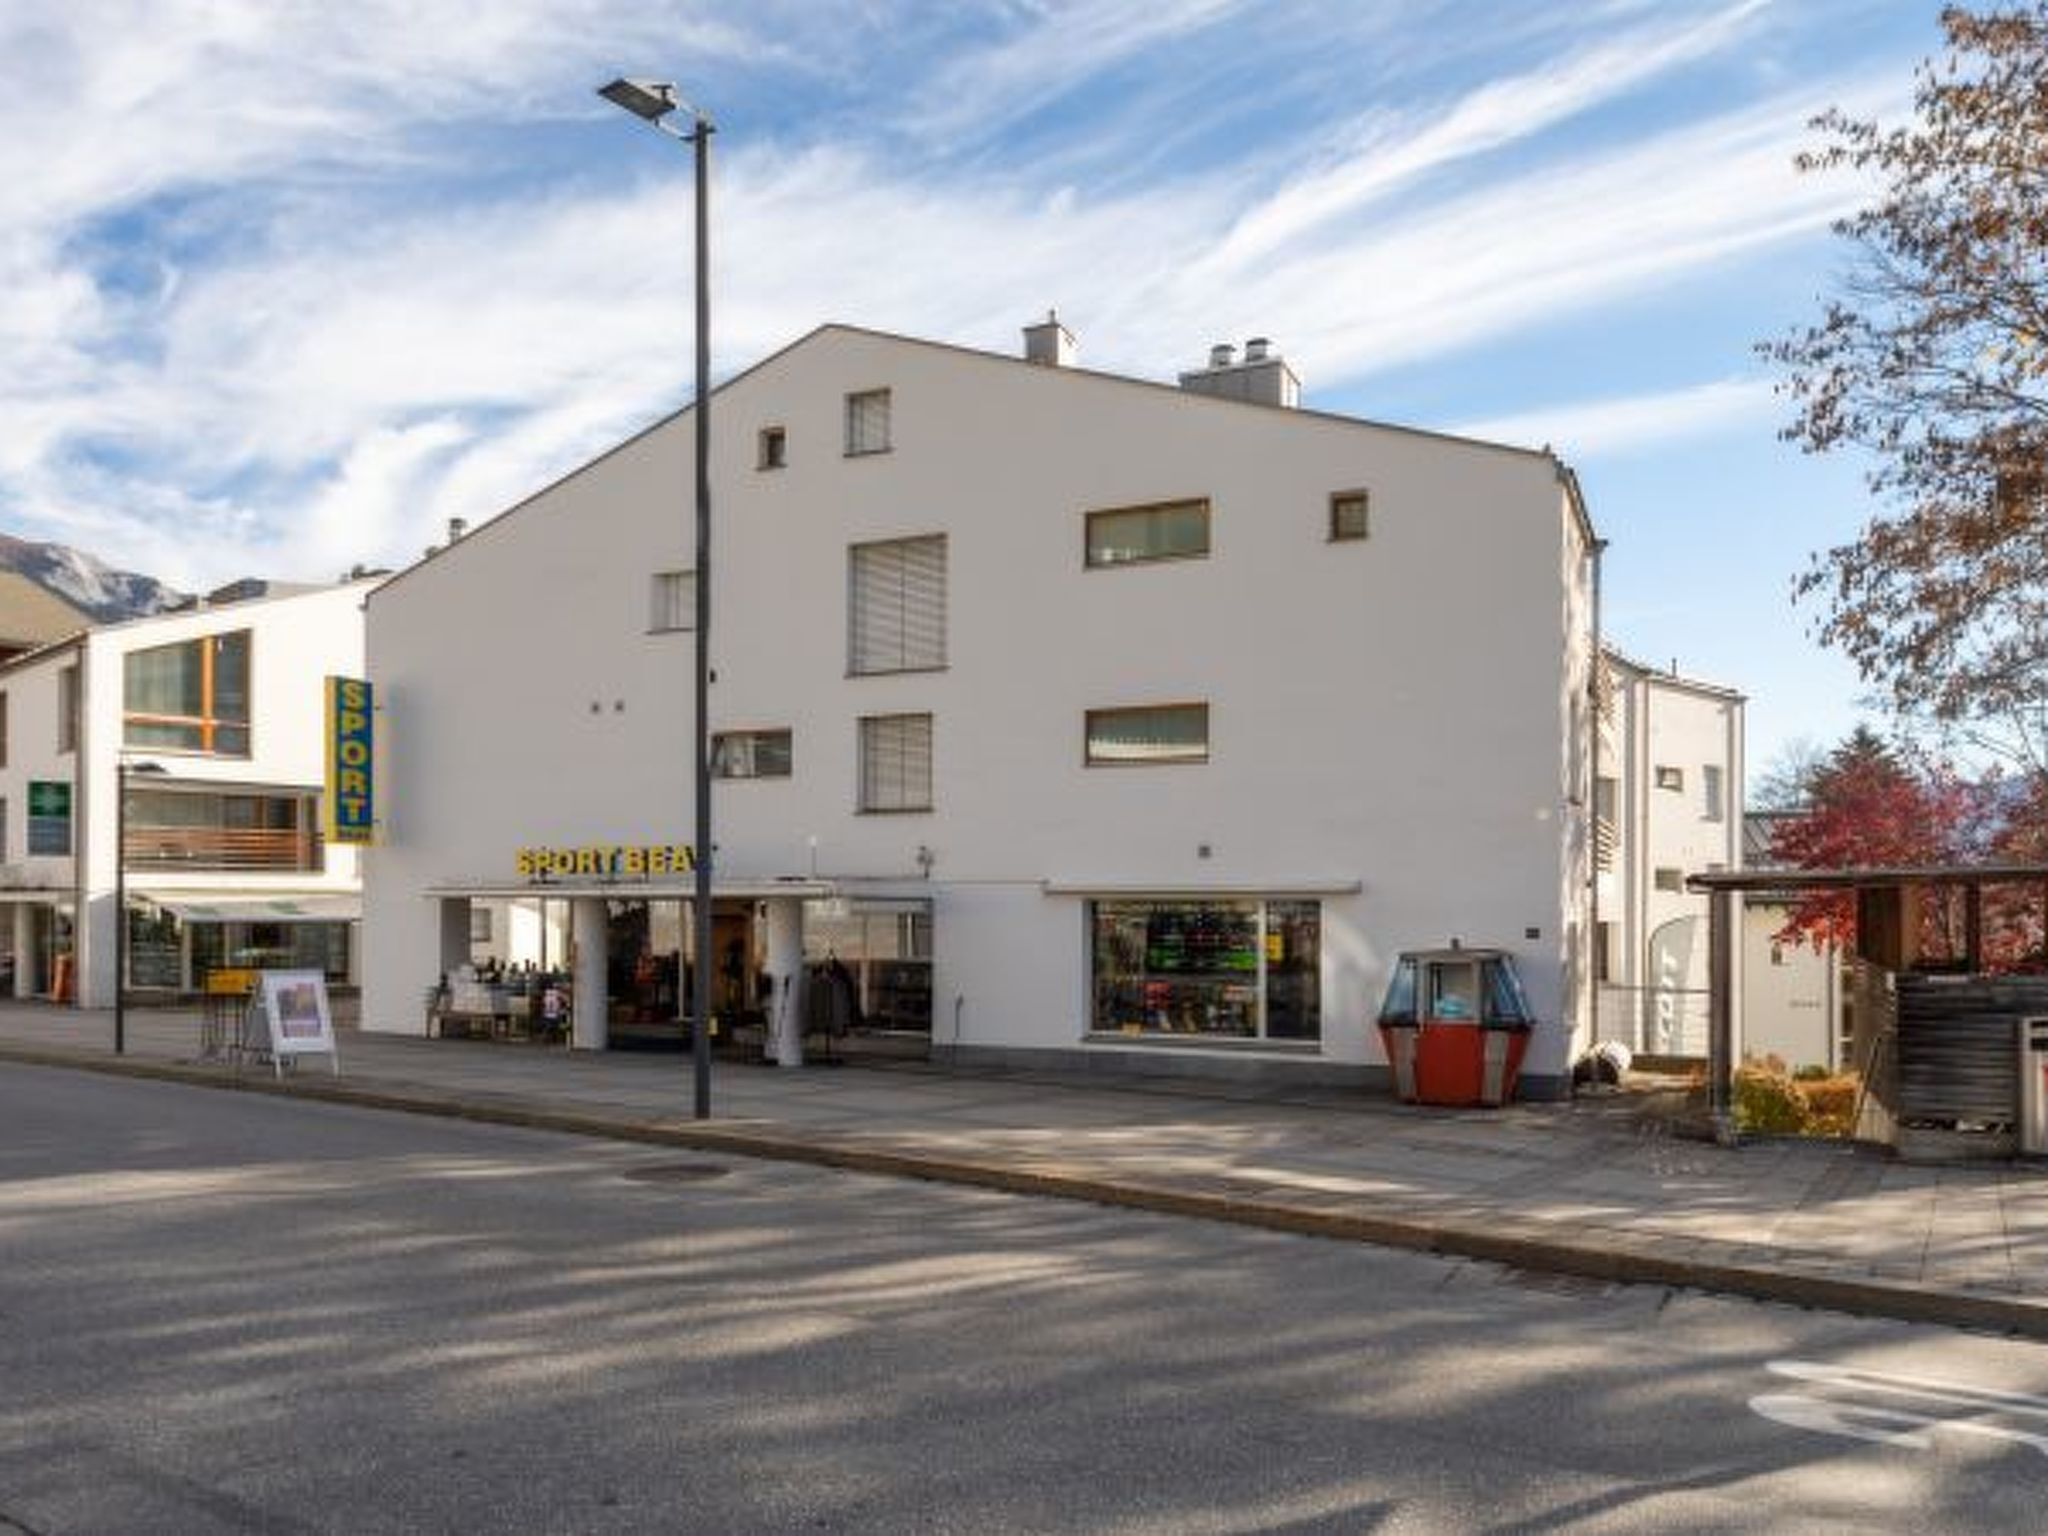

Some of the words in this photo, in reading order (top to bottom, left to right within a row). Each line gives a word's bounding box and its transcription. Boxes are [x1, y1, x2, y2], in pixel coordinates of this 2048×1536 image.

[341, 681, 368, 823] SPORT
[515, 845, 614, 875] SPORT
[625, 845, 704, 875] BEA
